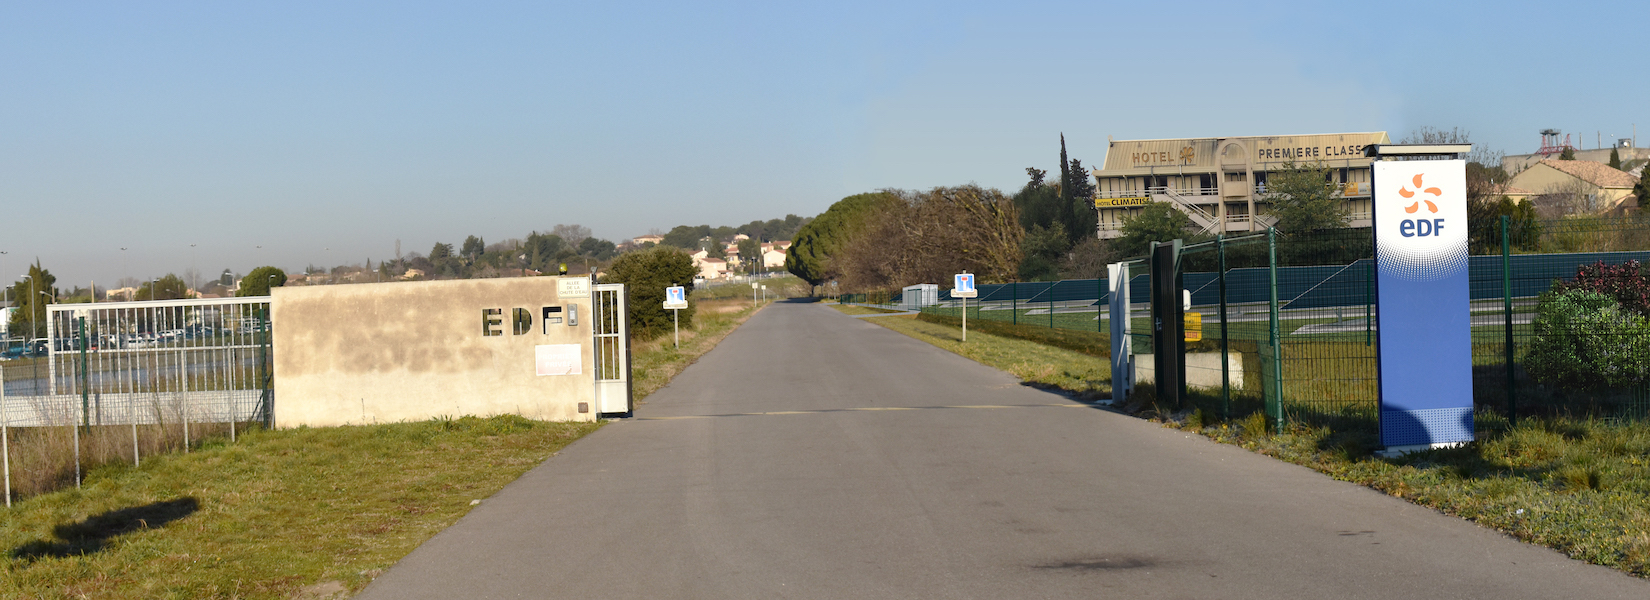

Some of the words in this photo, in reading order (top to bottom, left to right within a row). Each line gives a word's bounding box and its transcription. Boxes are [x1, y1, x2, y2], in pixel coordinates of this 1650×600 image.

[1132, 151, 1175, 163] HOTEL
[1258, 146, 1319, 159] PREMIERE
[1325, 144, 1363, 156] CLASS
[482, 306, 562, 337] EDF
